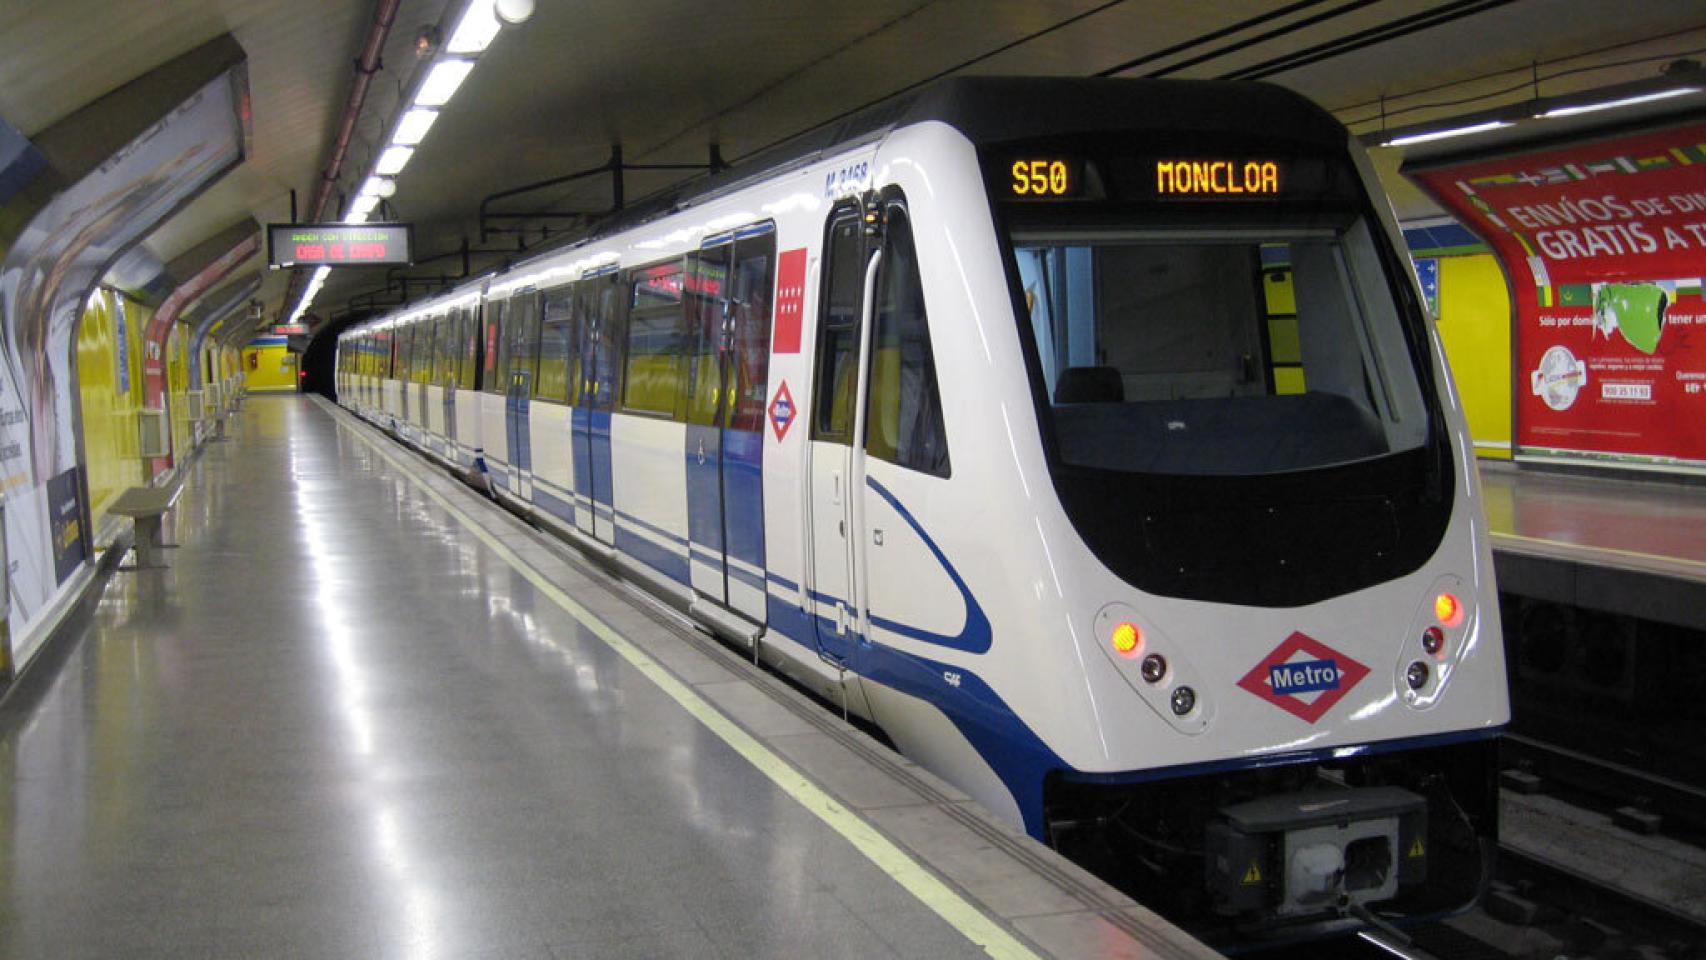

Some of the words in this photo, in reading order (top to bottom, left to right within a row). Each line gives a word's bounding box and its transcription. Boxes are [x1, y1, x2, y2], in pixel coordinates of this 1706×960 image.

[1012, 161, 1067, 195] S50
[1157, 162, 1278, 193] MONCLOA
[1507, 195, 1633, 228] ENVÍOS
[1631, 198, 1672, 217] DE
[1535, 222, 1657, 260] GRATIS
[1662, 226, 1689, 250] A
[1273, 665, 1335, 688] Metro
